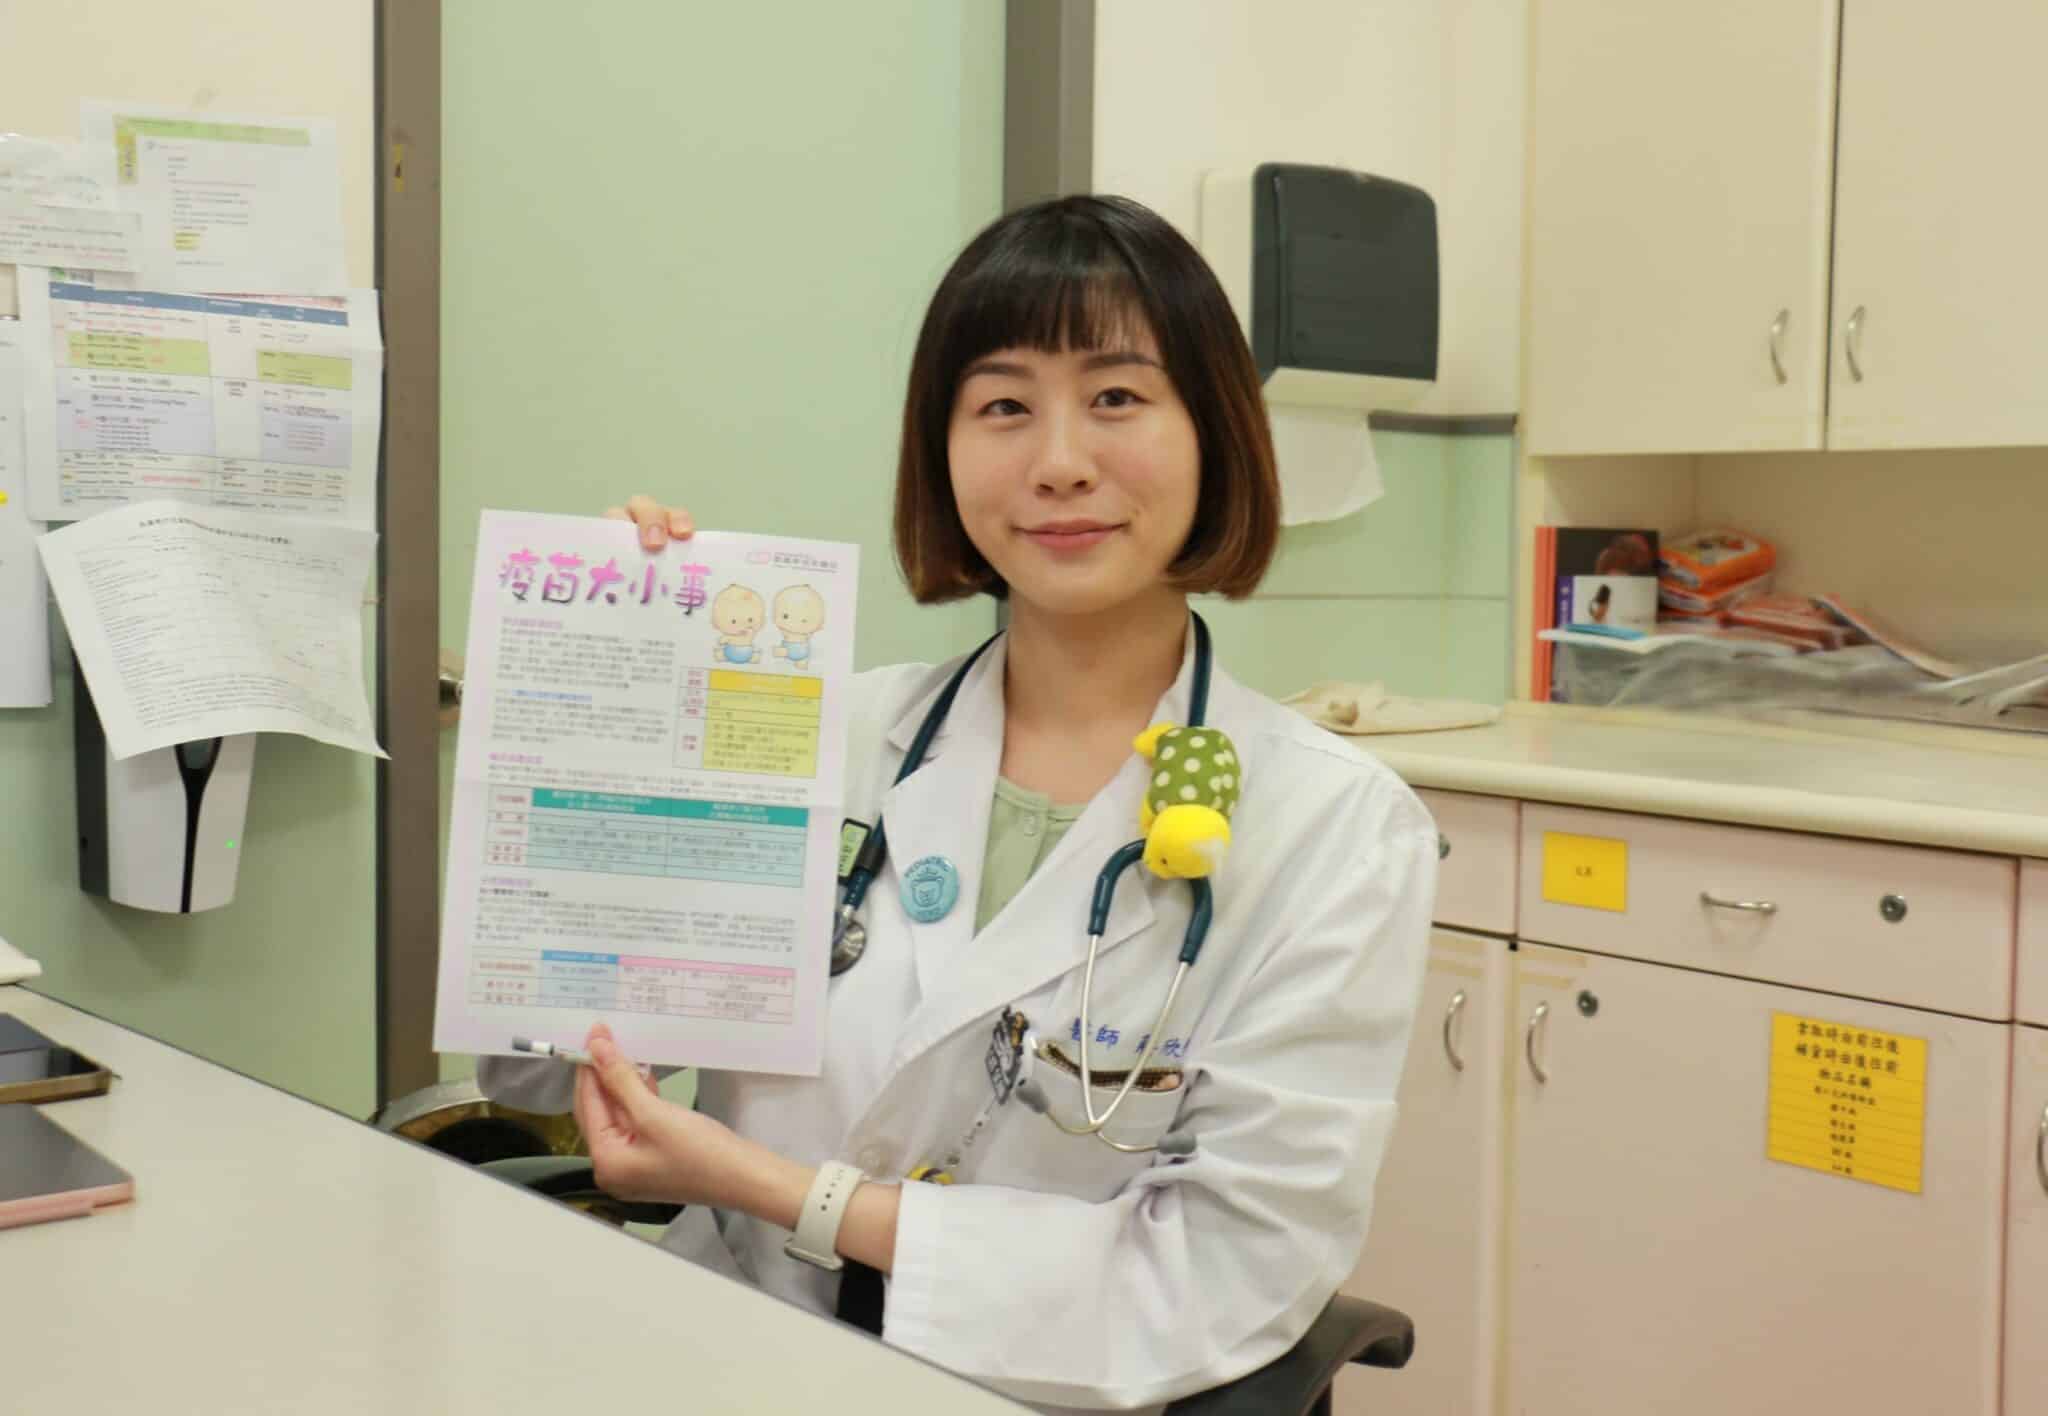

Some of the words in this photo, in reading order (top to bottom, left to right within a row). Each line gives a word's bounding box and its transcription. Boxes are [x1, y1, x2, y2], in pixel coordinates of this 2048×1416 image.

[498, 548, 712, 615] 疫苗大小事
